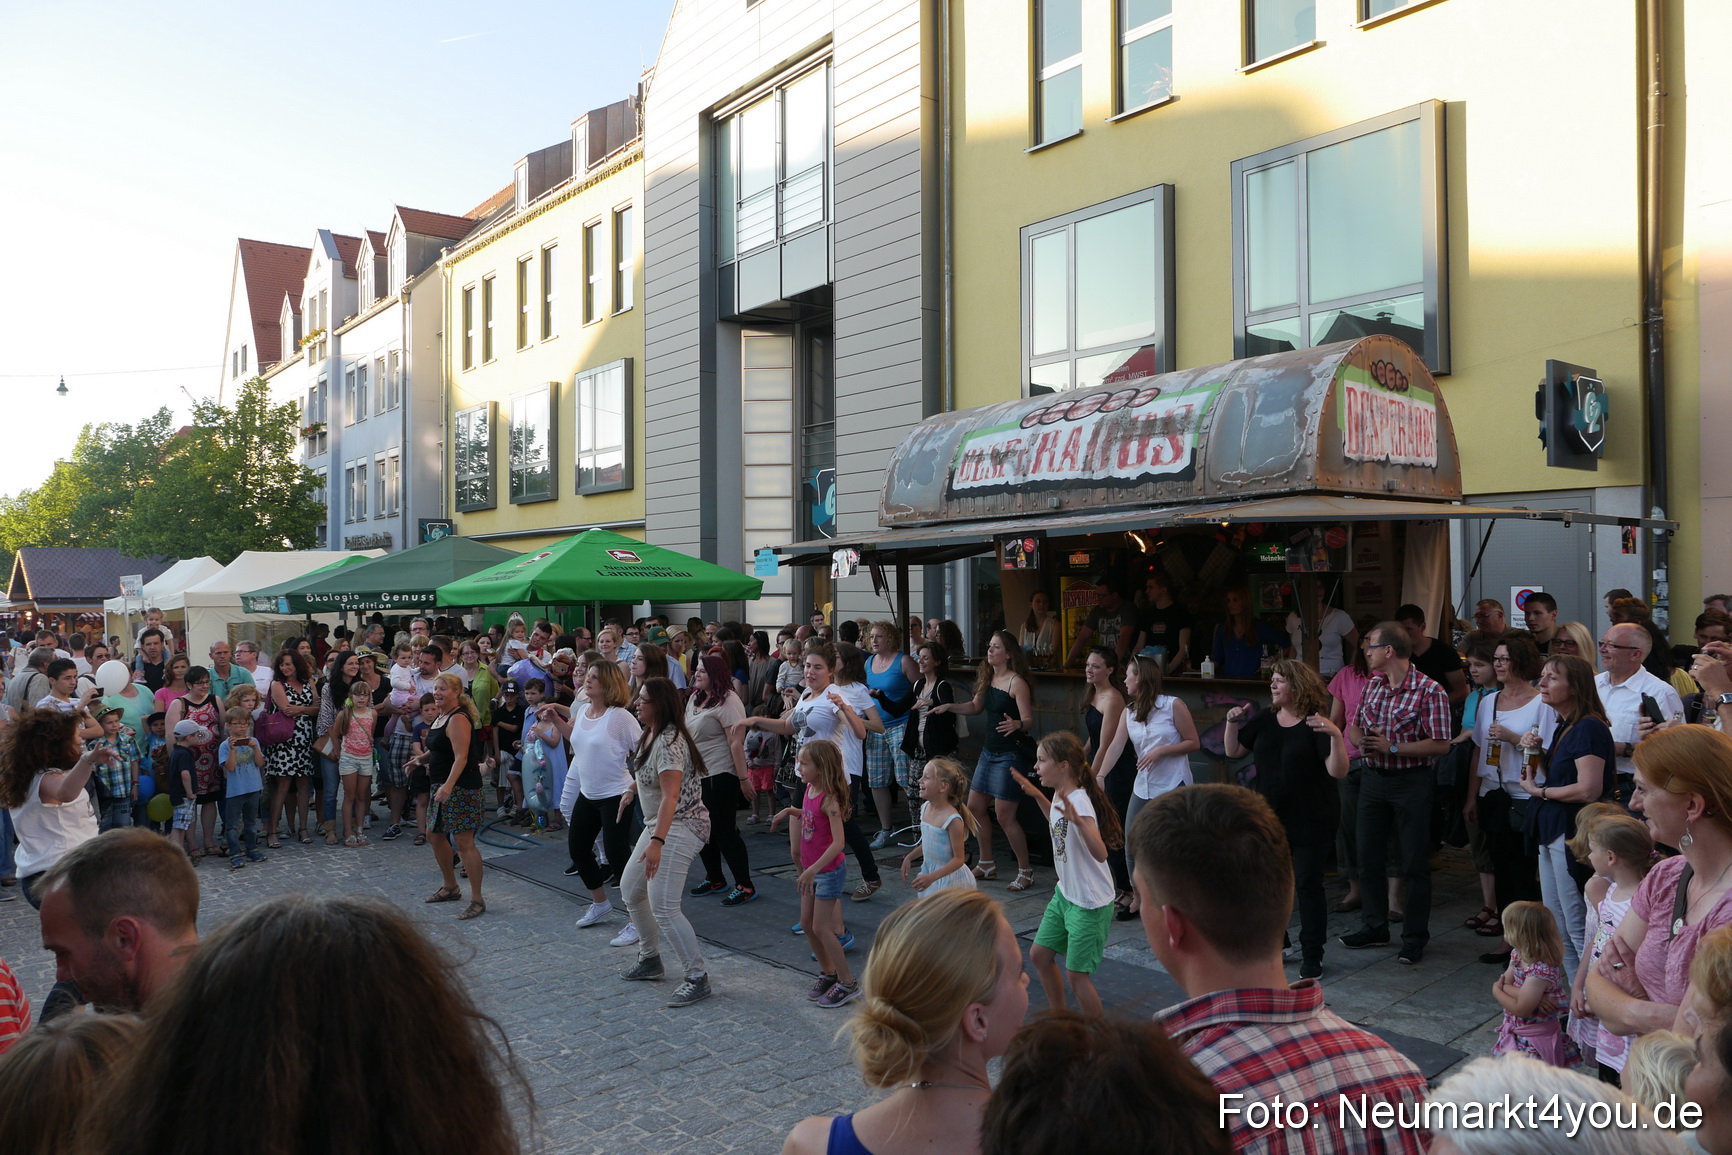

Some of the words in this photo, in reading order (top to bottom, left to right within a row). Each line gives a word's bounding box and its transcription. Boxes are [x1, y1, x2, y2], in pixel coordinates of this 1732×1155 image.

[1128, 371, 1148, 380] MWST
[1345, 386, 1437, 458] DESPERADOS
[1260, 554, 1287, 562] Heineke
[595, 569, 693, 578] Lammsbräu
[306, 593, 360, 602] Ökologie
[381, 592, 435, 602] Genuss
[340, 602, 392, 610] Tradition
